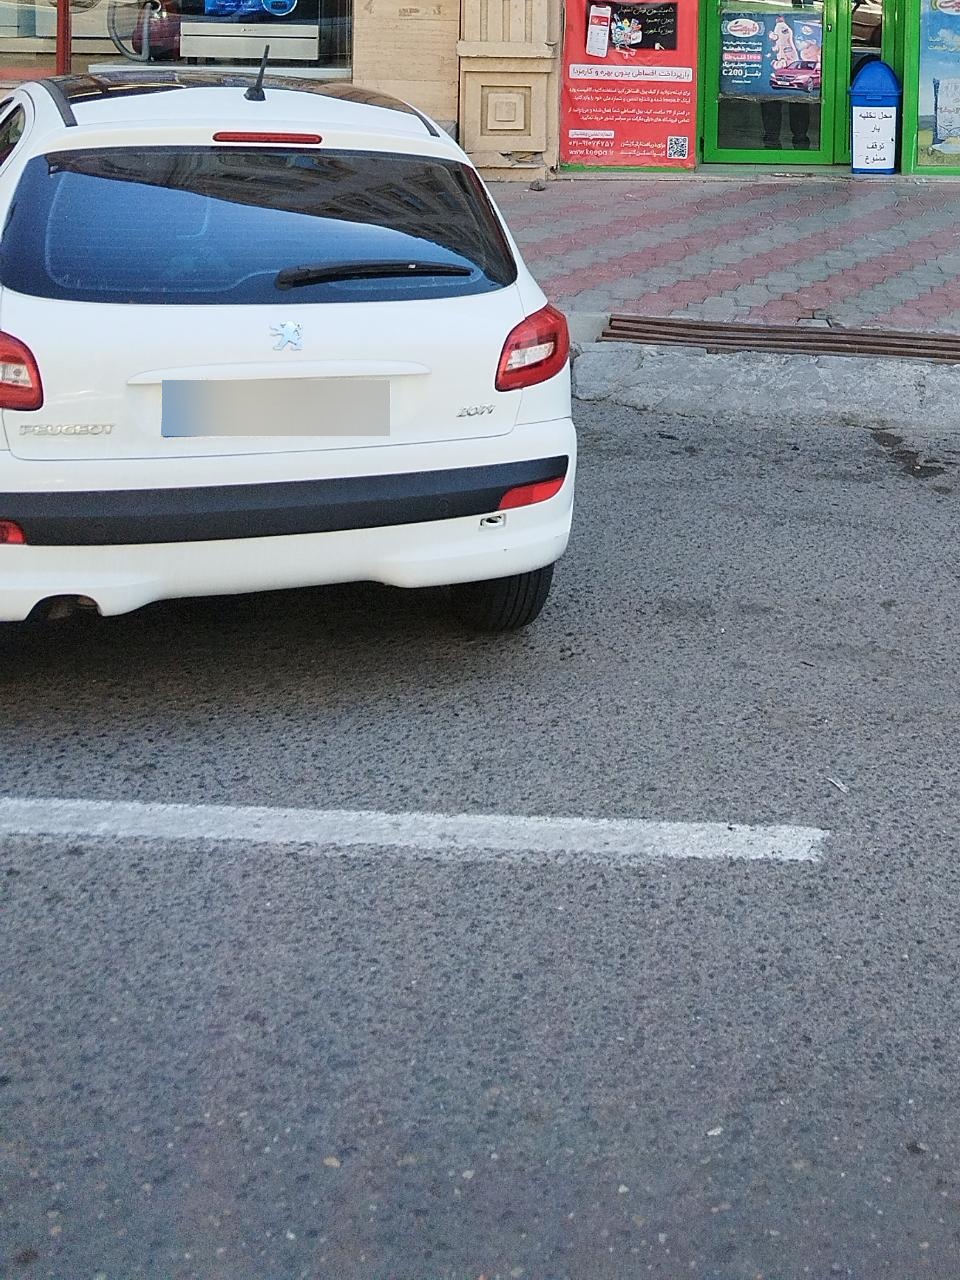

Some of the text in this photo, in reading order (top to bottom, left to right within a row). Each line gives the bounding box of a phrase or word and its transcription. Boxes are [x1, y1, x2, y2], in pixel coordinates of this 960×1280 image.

[600, 69, 613, 77] بهره
[614, 70, 631, 78] بدون
[631, 69, 657, 79] اقساطی
[658, 70, 691, 80] بازپرداخت
[859, 110, 893, 121] محل تخلیه
[871, 124, 881, 133] بار
[866, 141, 885, 151] توقف
[864, 153, 887, 165] ممنوع
[19, 423, 115, 437] PEUGEOT
